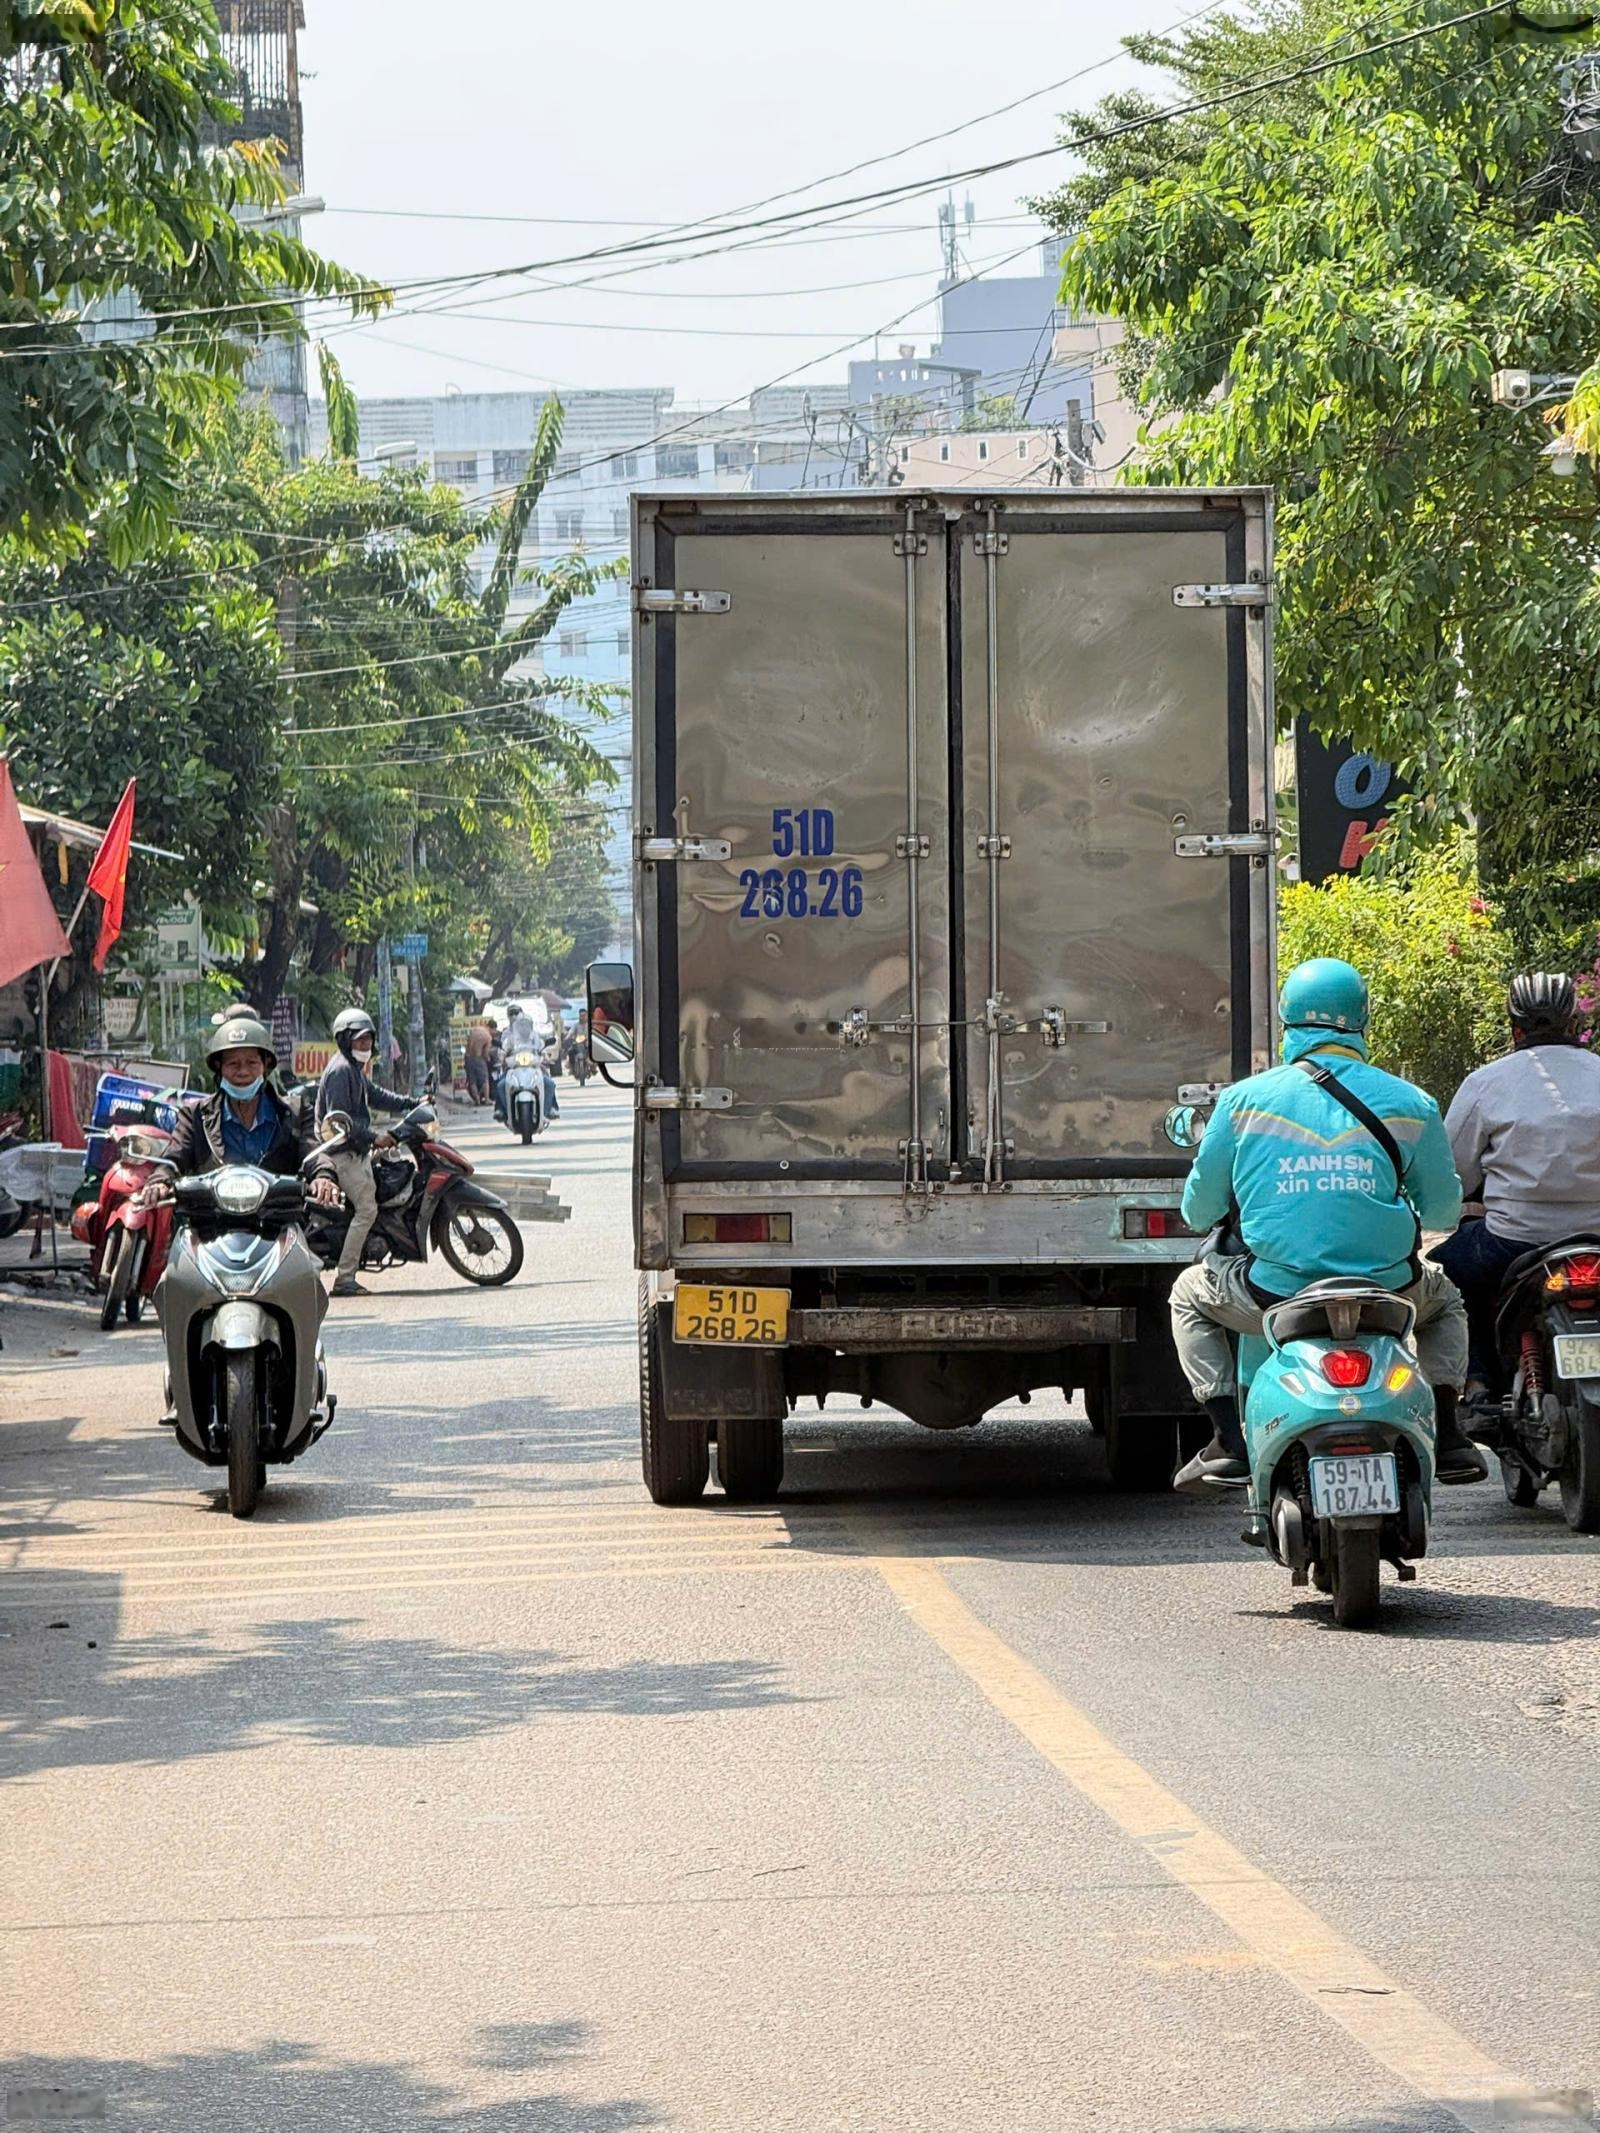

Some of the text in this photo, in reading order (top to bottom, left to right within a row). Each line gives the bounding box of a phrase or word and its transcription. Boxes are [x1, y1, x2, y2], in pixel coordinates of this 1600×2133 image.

[772, 808, 834, 857] 51D
[739, 868, 863, 918] 268.26
[1276, 1172, 1377, 1195] xin chào!
[708, 1290, 757, 1315] 51D
[687, 1315, 777, 1343] 268.26
[1323, 1458, 1385, 1486] 59-TA
[1322, 1484, 1393, 1514] 187.44
